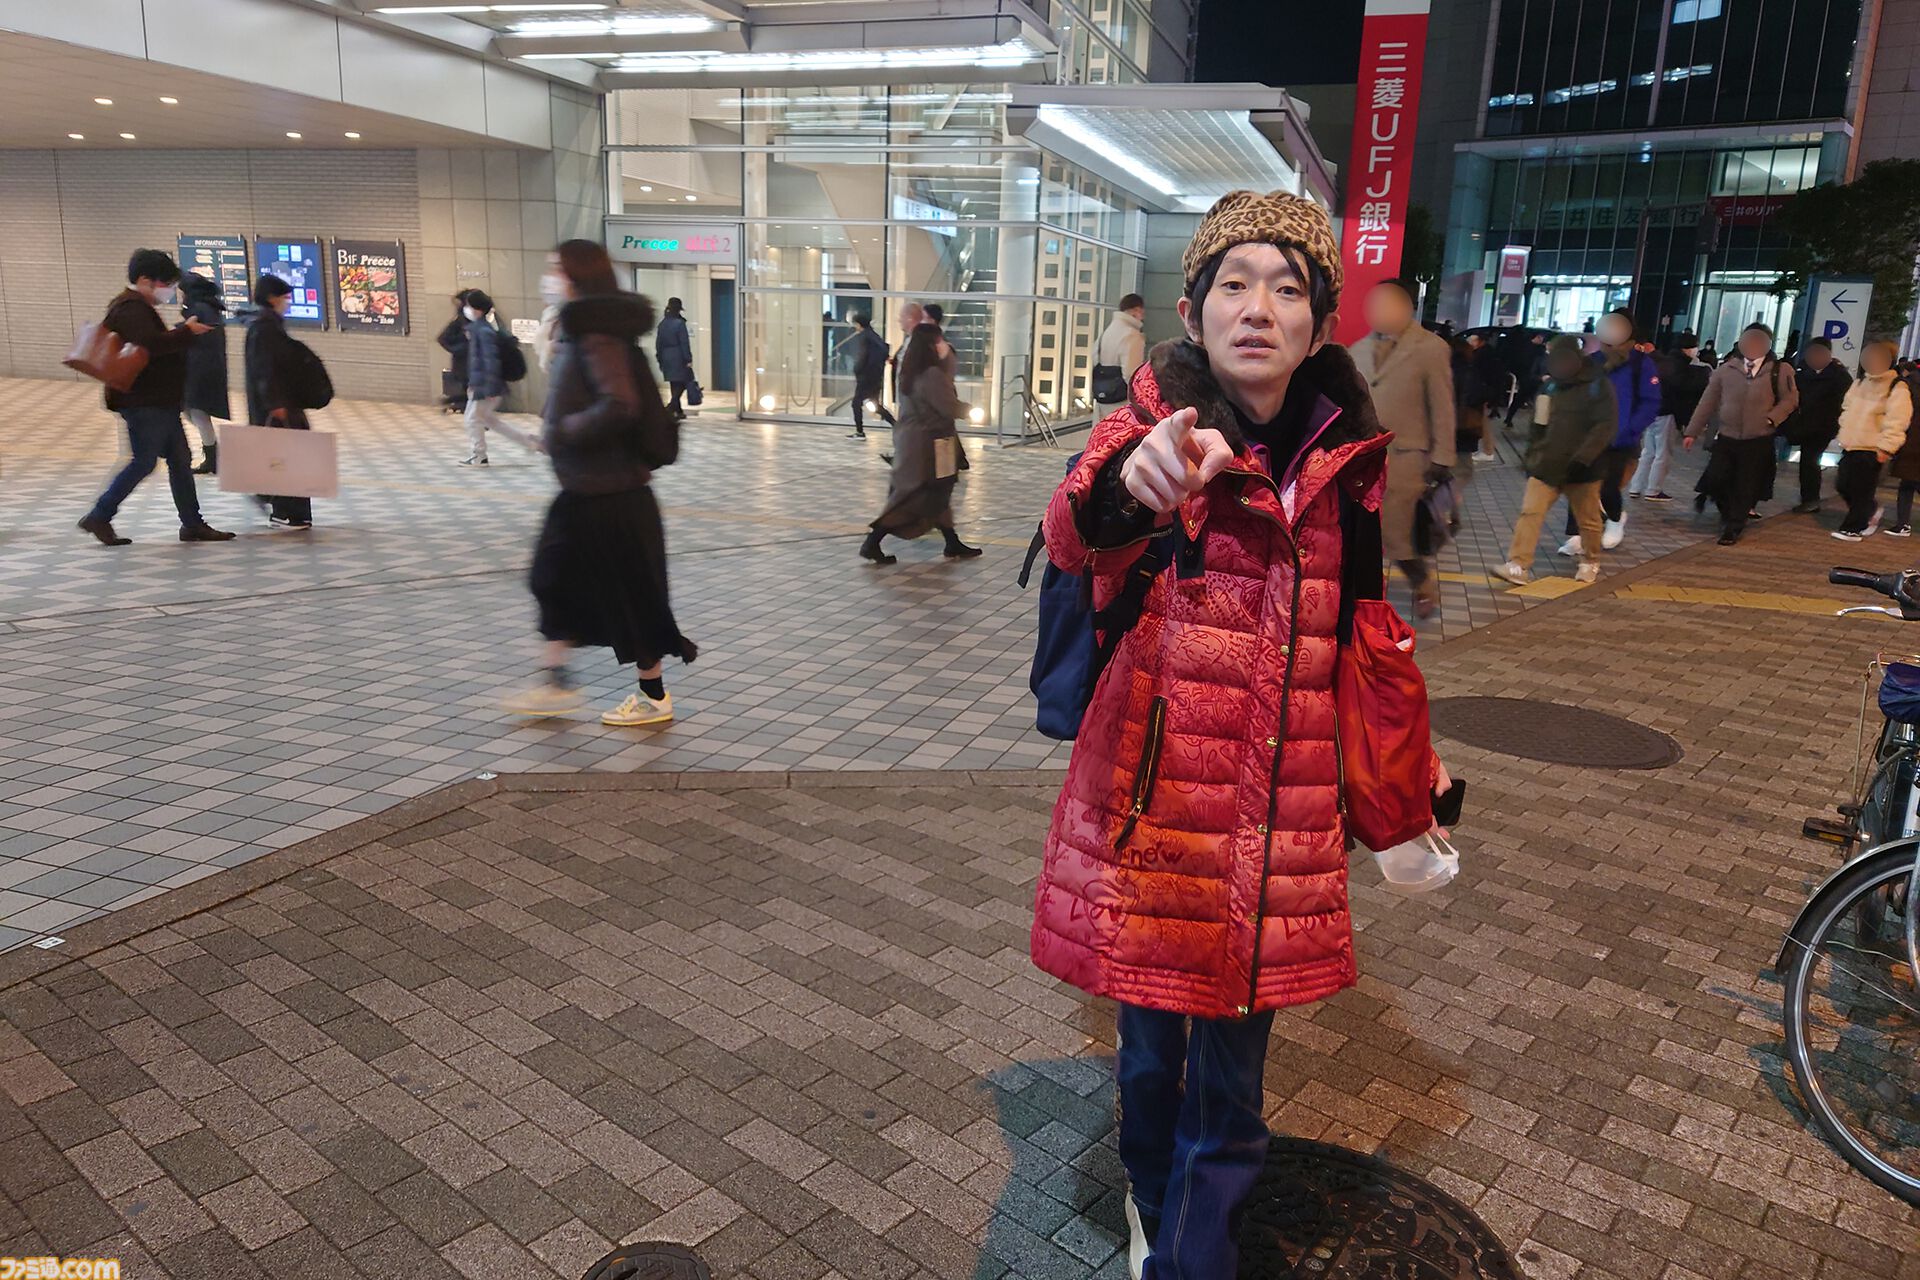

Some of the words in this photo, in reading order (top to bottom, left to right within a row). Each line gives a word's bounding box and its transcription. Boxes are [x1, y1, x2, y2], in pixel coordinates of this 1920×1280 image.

[1355, 42, 1408, 264] 三菱UFJ銀行
[194, 239, 227, 247] INFORMATION
[622, 235, 679, 251] Precce
[722, 237, 732, 252] 2
[360, 254, 396, 266] Precce
[1823, 320, 1849, 341] P
